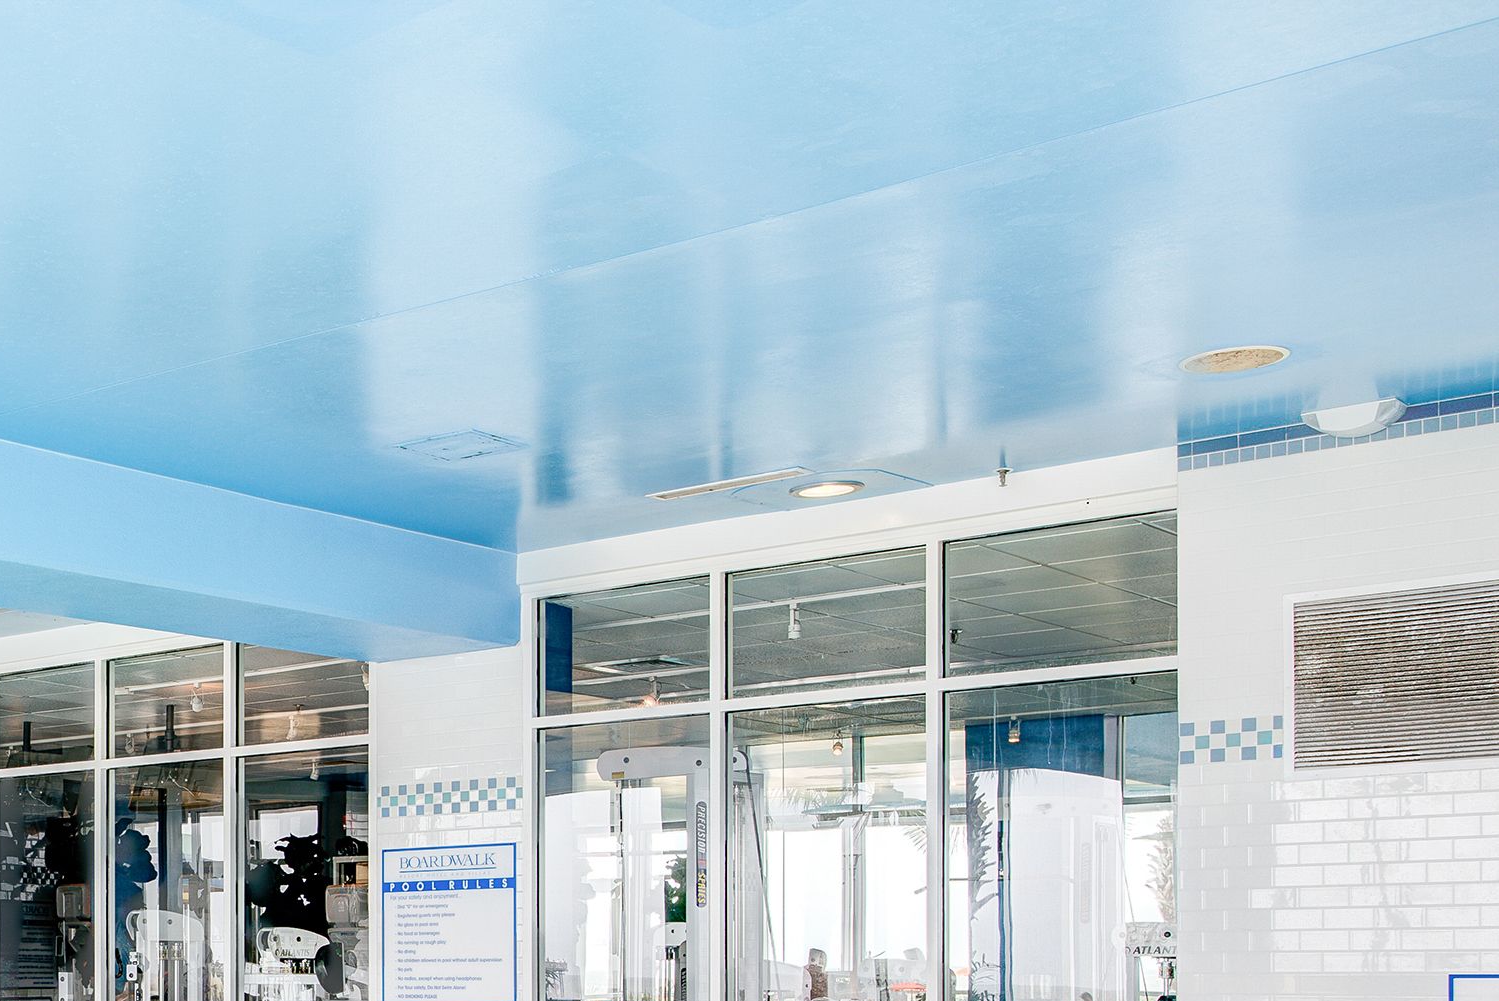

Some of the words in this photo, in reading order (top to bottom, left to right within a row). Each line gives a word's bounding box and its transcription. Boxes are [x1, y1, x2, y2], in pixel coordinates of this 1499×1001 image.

[697, 806, 706, 854] PRECISION
[400, 852, 496, 869] BOARDWALK
[390, 882, 436, 891] POOL
[449, 878, 508, 889] RULES
[697, 872, 706, 903] SERIES
